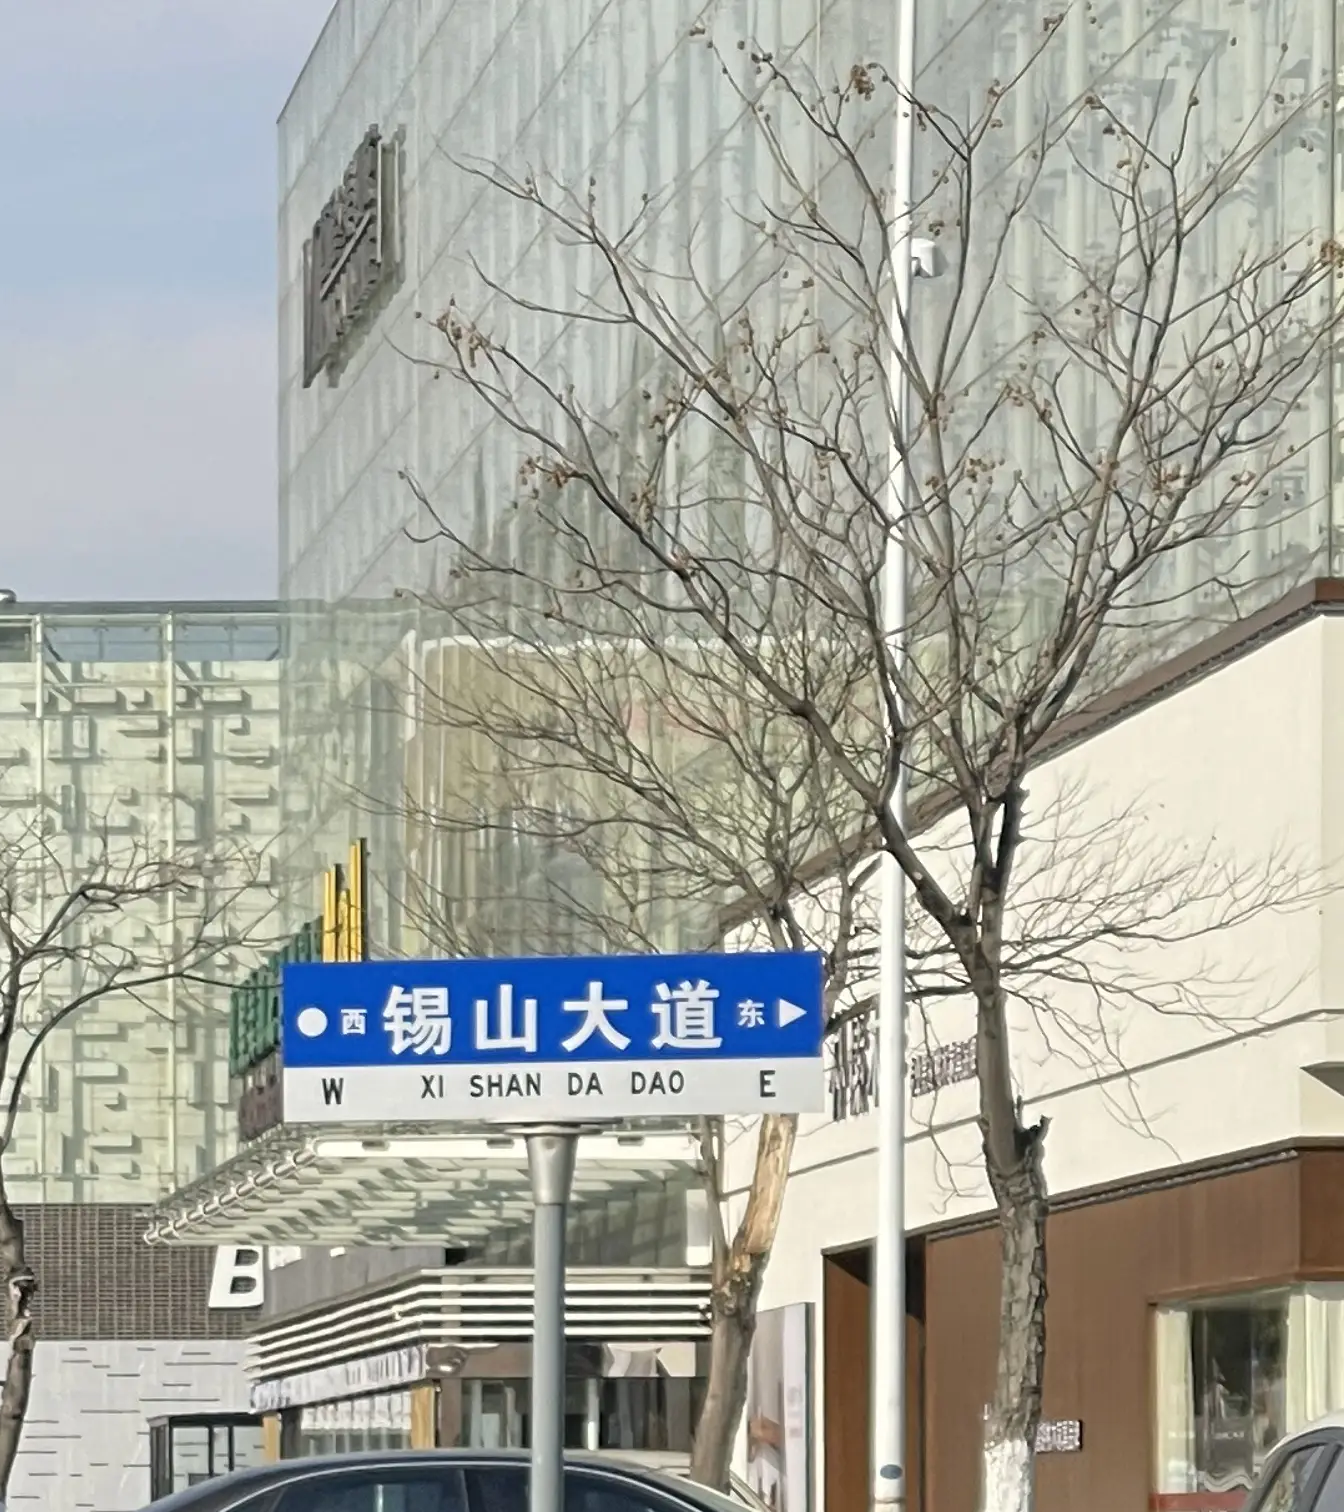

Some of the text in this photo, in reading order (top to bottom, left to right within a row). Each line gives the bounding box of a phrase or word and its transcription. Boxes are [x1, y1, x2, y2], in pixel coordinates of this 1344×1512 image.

[341, 979, 765, 1056] 西 锡山大道 东
[322, 1070, 776, 1105] W XI SHAN DA DAO E
